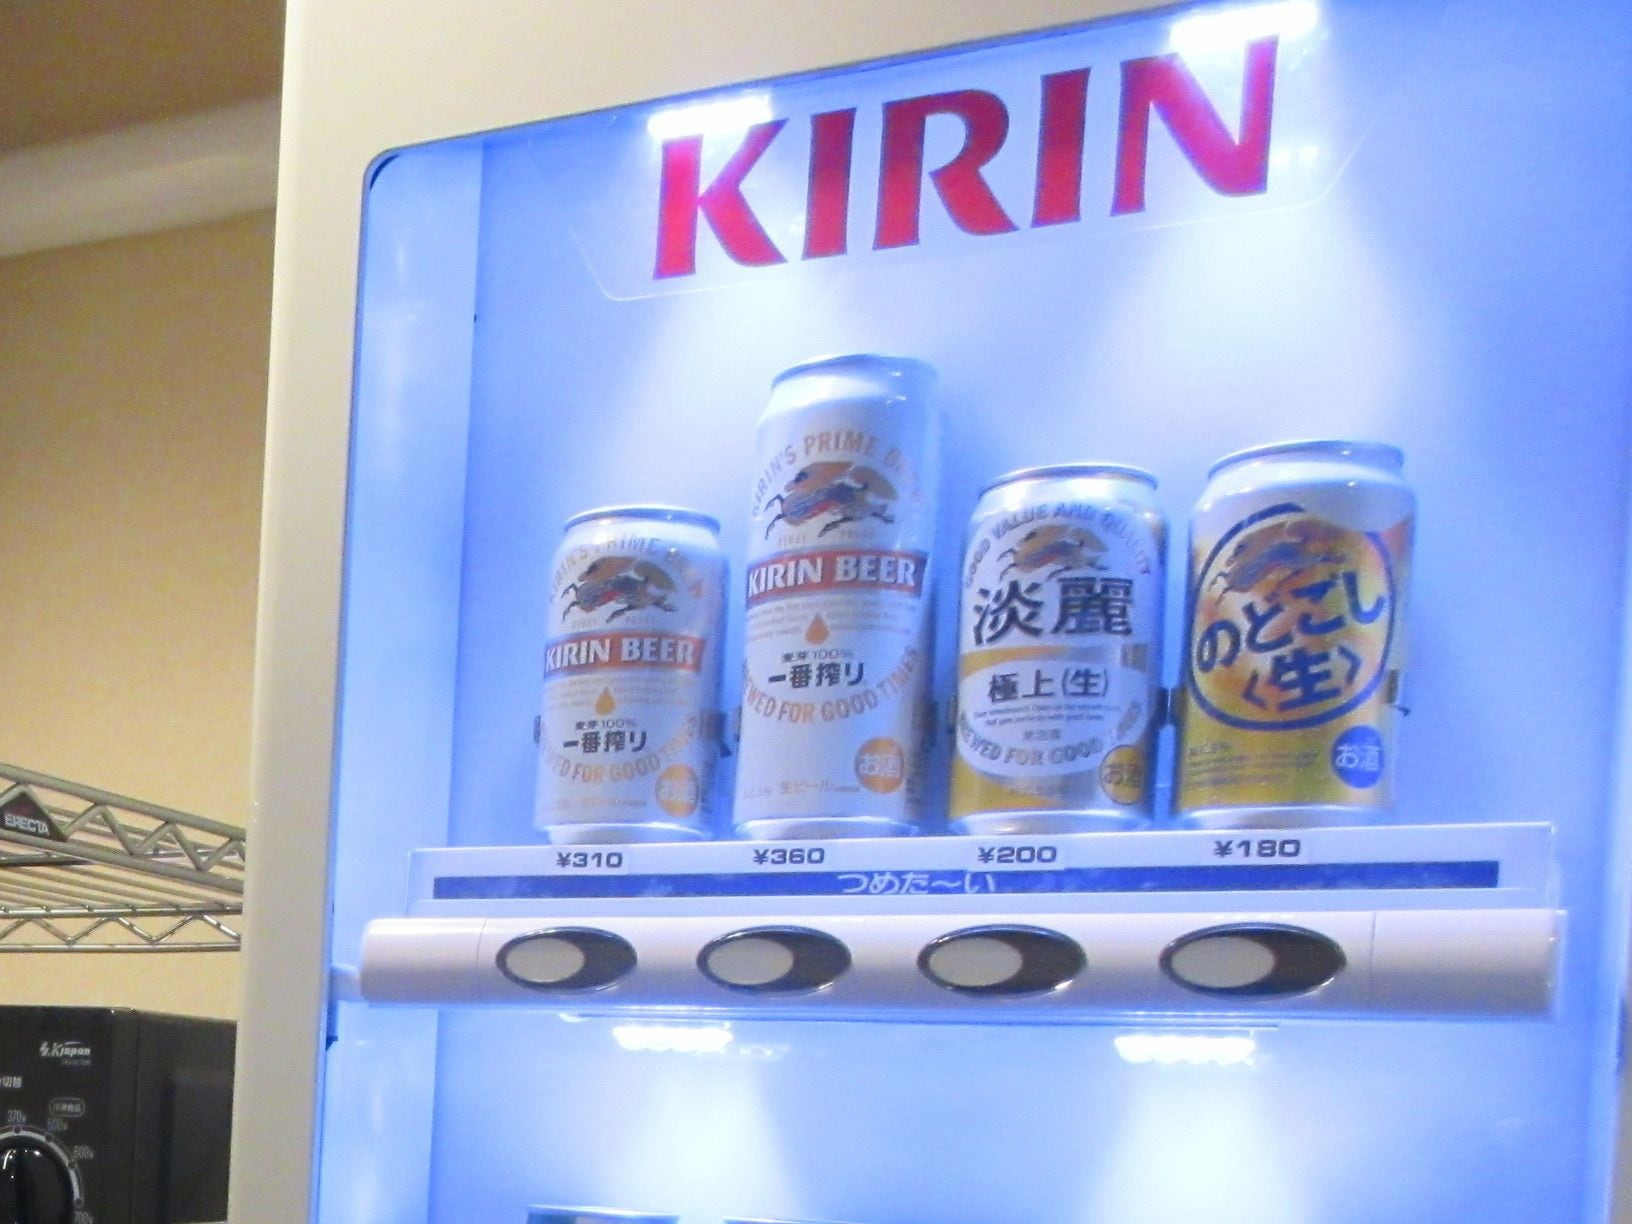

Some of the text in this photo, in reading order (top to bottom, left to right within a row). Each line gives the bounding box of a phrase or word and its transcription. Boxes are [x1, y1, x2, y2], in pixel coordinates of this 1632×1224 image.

[653, 35, 1280, 280] KIRIN
[748, 556, 824, 598] KIRIN
[834, 554, 917, 587] BEER
[972, 575, 1135, 646] 淡麗
[1195, 571, 1388, 675] のどこし
[545, 636, 695, 673] KIRIN BEER
[768, 662, 864, 689] 一番搾り
[562, 730, 648, 754] 一番搾り
[556, 851, 624, 869] ¥310
[752, 847, 826, 866] ¥360
[977, 846, 1058, 865] ¥200
[1213, 838, 1302, 859] ¥180
